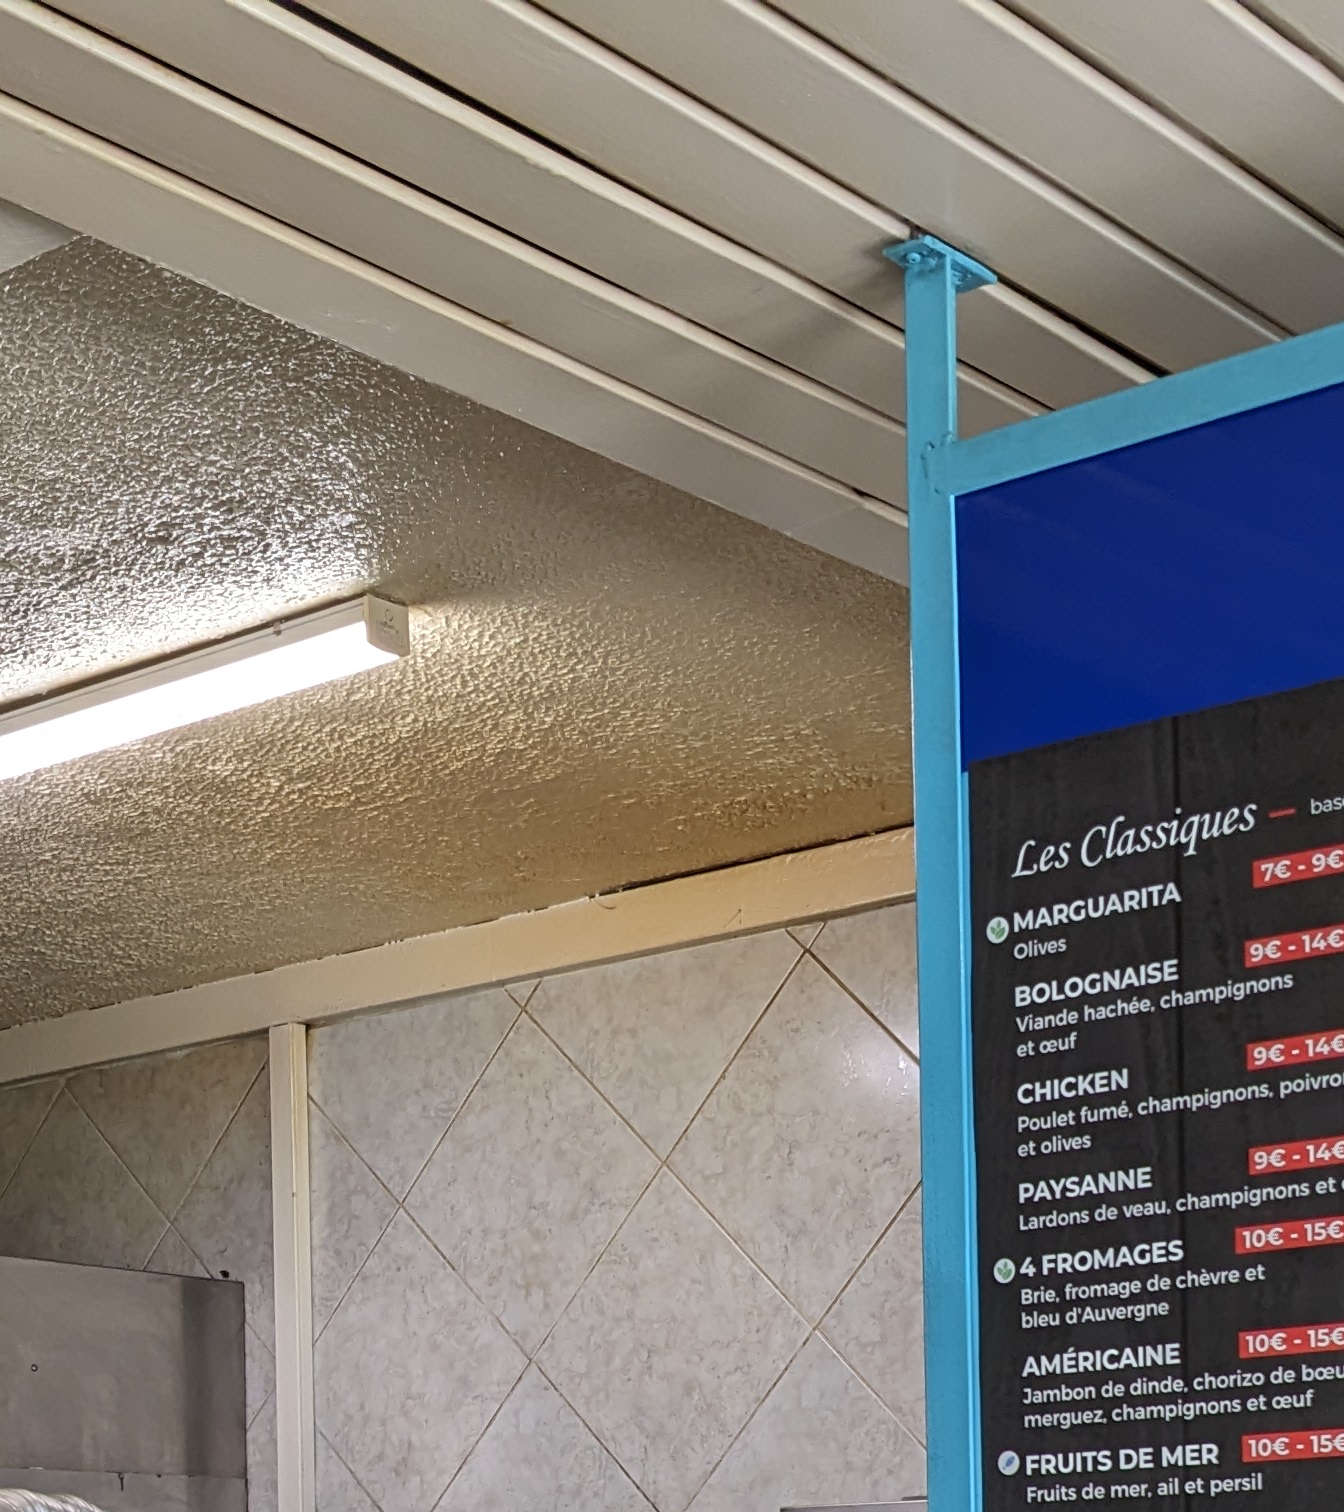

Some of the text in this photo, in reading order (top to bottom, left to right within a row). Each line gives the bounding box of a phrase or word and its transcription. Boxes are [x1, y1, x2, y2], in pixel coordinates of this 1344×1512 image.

[1011, 803, 1258, 878] Les Classiques
[1260, 859, 1292, 882] 7€
[1311, 849, 1344, 873] 9€
[1013, 881, 1182, 933] MARGUARITA
[1013, 938, 1067, 960] Olives
[1014, 958, 1179, 1008] BOLOGNAISE
[1015, 974, 1294, 1033] Viande hachée, champignons
[1016, 1067, 1129, 1105] CHICKEN
[1018, 1166, 1153, 1204] PAYSANNE
[1019, 1239, 1184, 1278] 4 FROMAGES
[1021, 1301, 1170, 1329] bleu d'Auvergne
[1021, 1342, 1182, 1378] AMÉRICAINE
[1025, 1443, 1220, 1476] FRUITS DE MER
[1026, 1472, 1263, 1504] Fruits de mer, ail et persil
